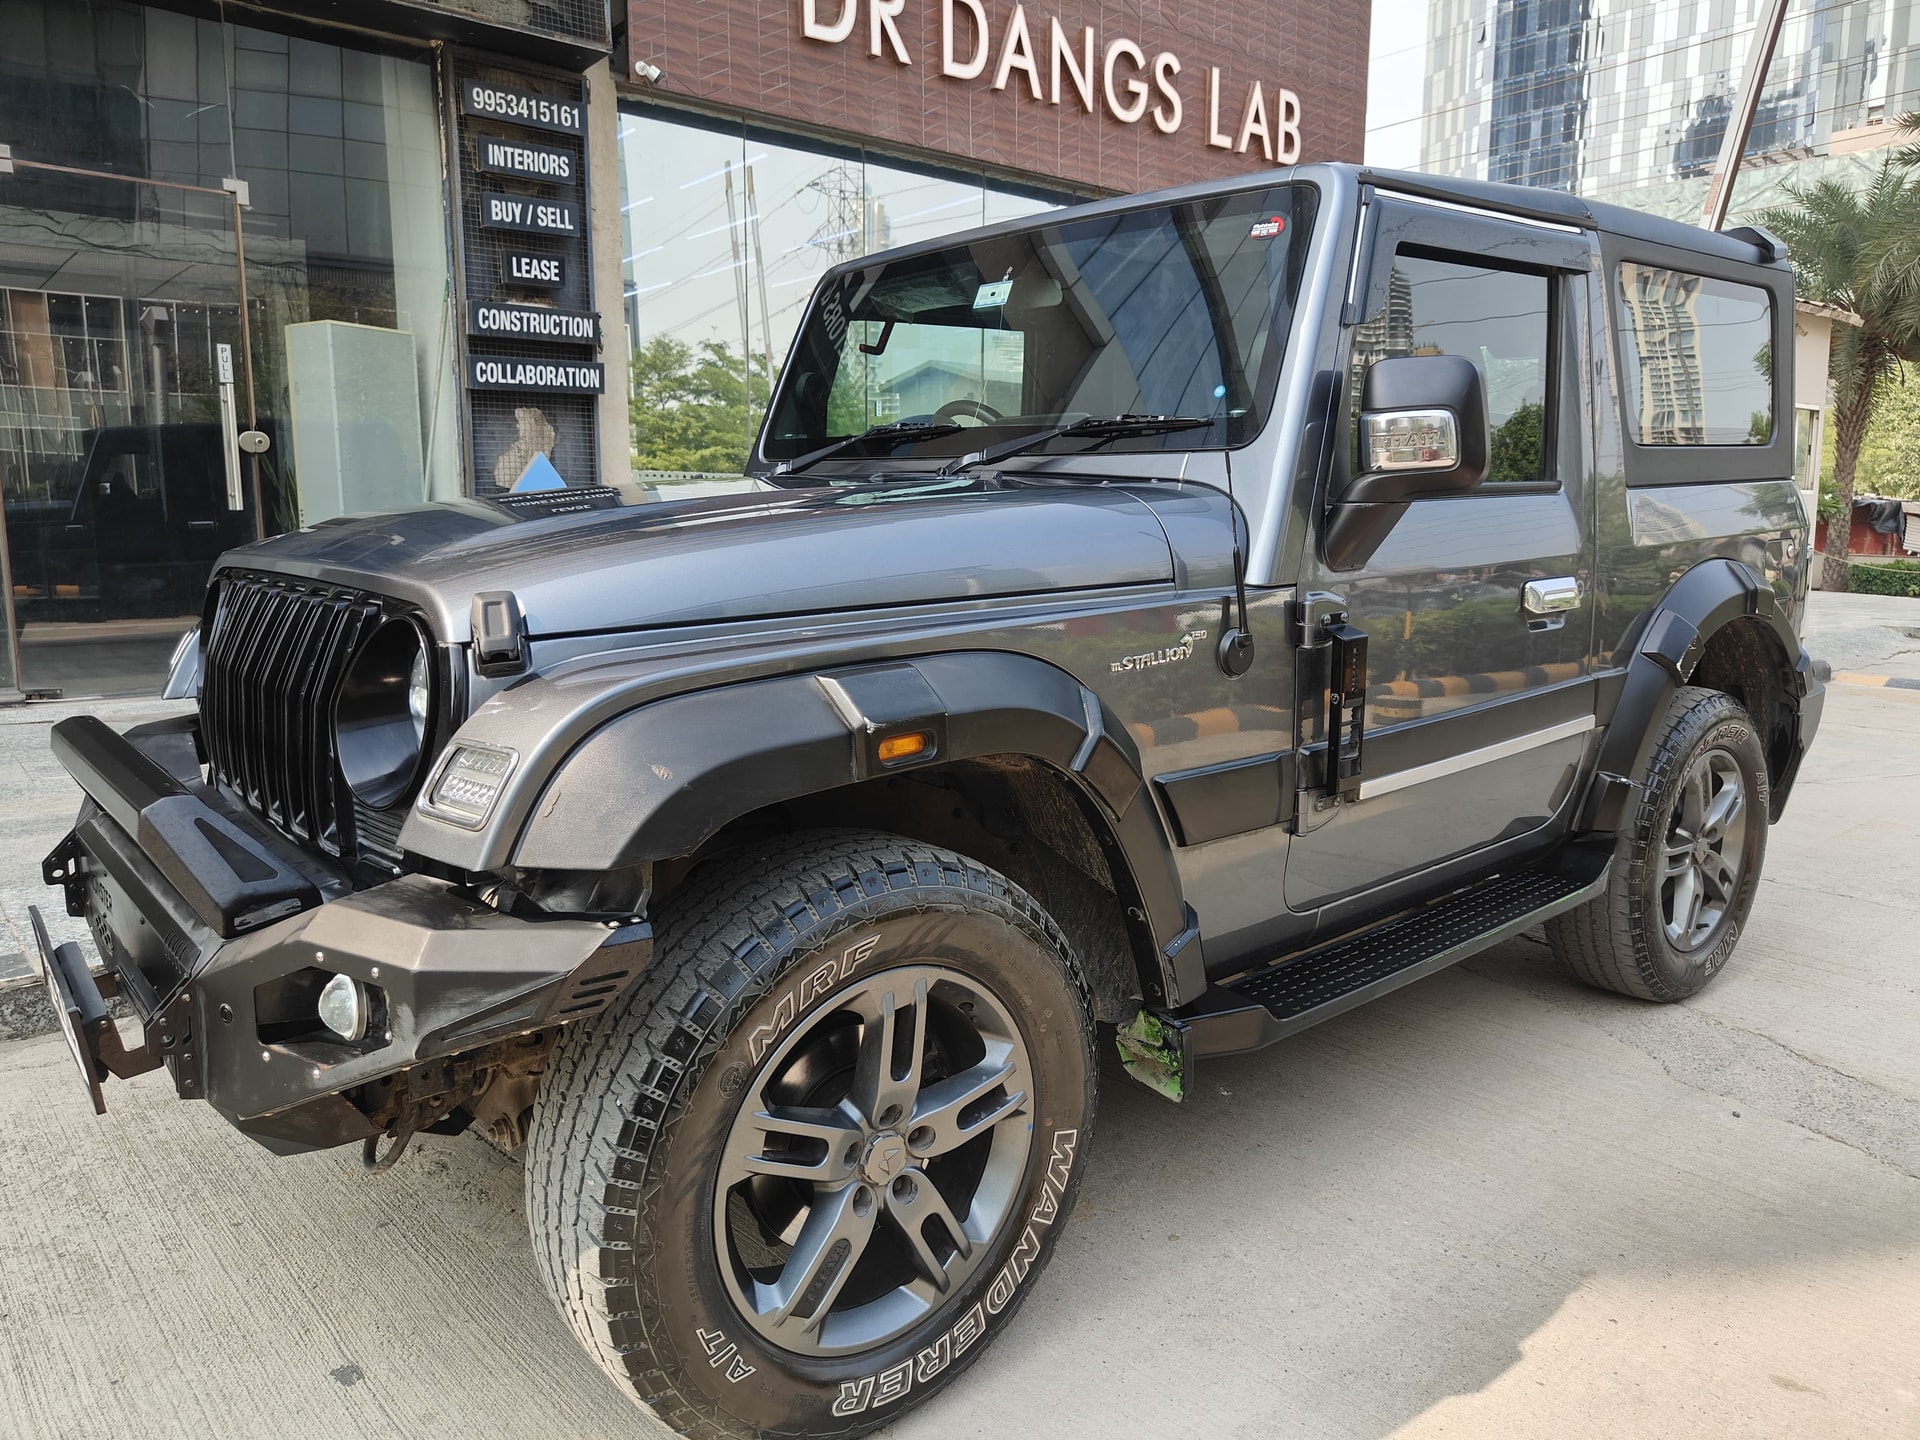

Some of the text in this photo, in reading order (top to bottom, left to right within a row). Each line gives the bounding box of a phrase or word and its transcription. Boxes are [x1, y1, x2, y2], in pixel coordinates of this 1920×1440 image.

[941, 0, 1182, 135] DANGS
[1206, 66, 1301, 165] LAB
[472, 87, 580, 129] 9953415161
[488, 144, 570, 177] INTERIORS
[491, 200, 574, 230] BUY / SELL
[512, 256, 560, 281] LEASE
[478, 307, 594, 338] CONSTRUCTION
[220, 347, 230, 380] PULL
[475, 361, 600, 388] COLLABORATION
[1704, 920, 1739, 976] MRF
[747, 933, 881, 1066] MRF
[831, 1129, 1078, 1417] WANDERER
